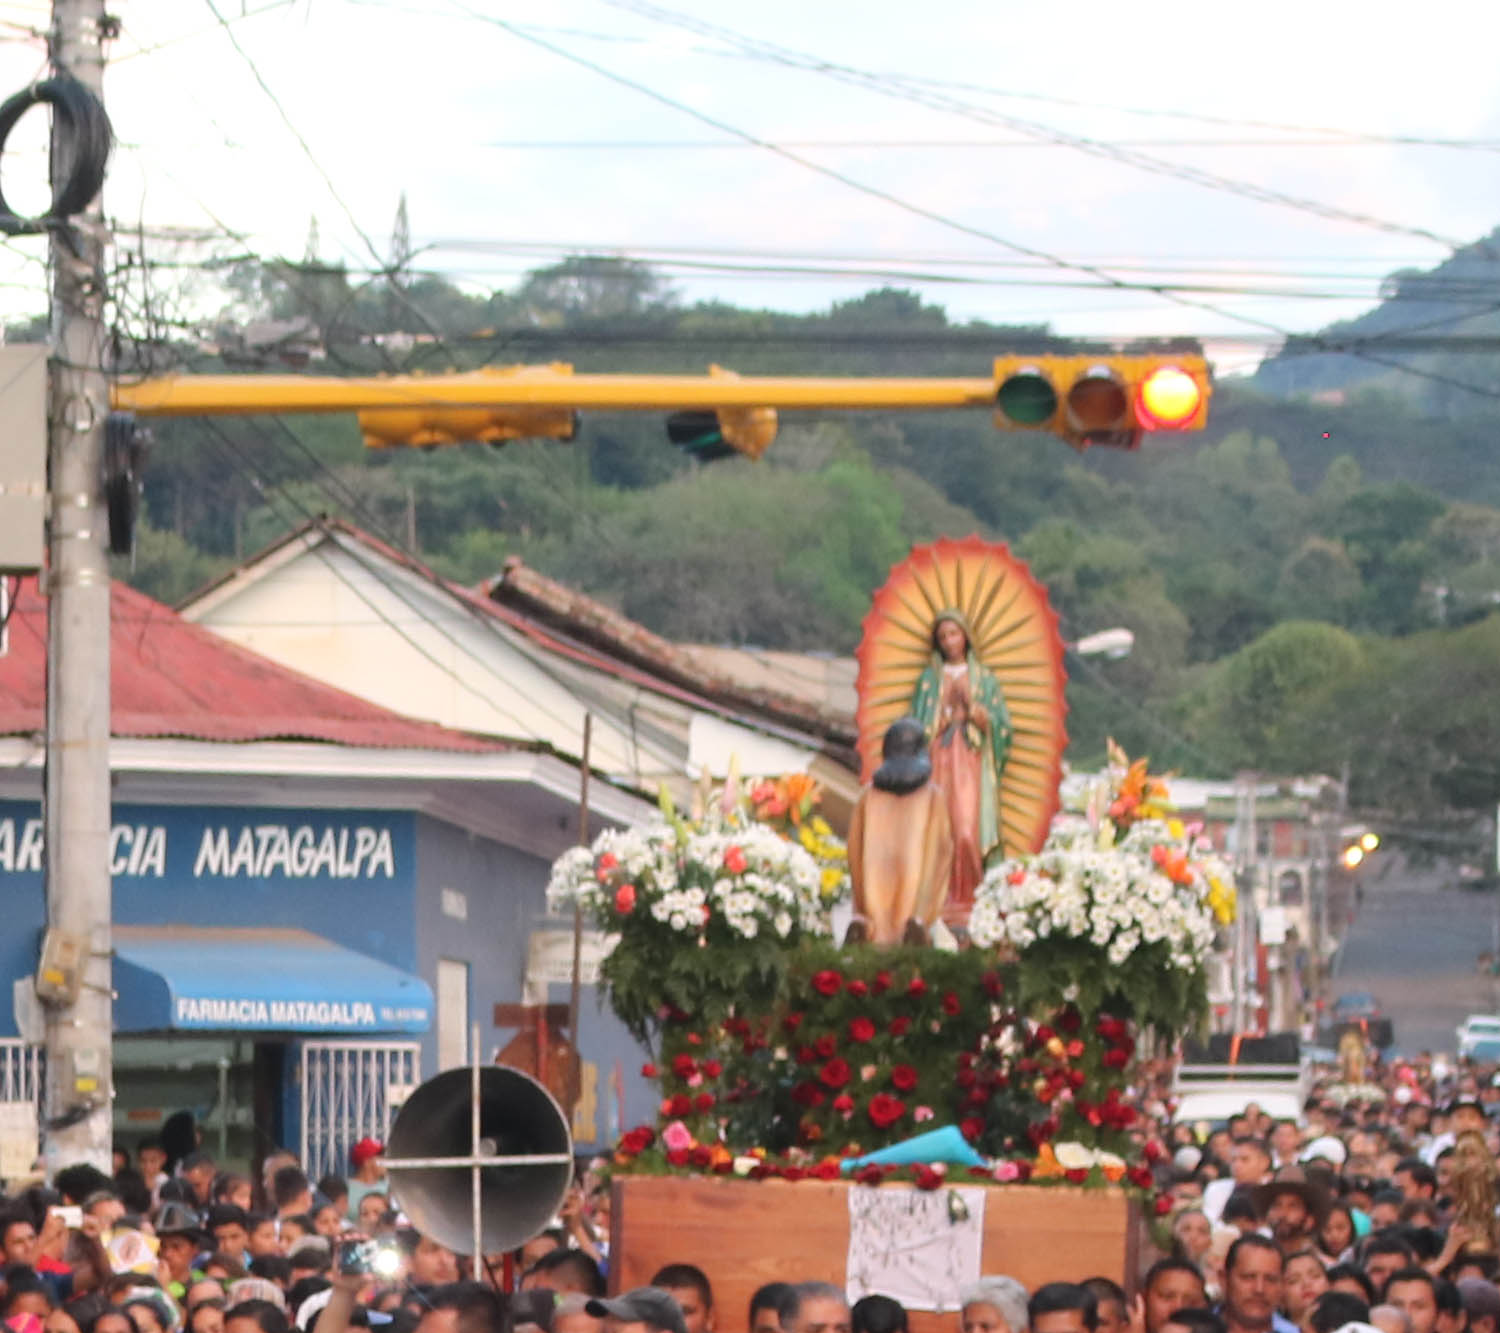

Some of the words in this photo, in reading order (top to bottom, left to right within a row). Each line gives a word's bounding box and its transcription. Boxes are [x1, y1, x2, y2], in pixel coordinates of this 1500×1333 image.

[194, 826, 395, 879] MATAGALPA
[177, 998, 268, 1023] FARMACIA
[270, 1001, 376, 1025] MATAGALPA
